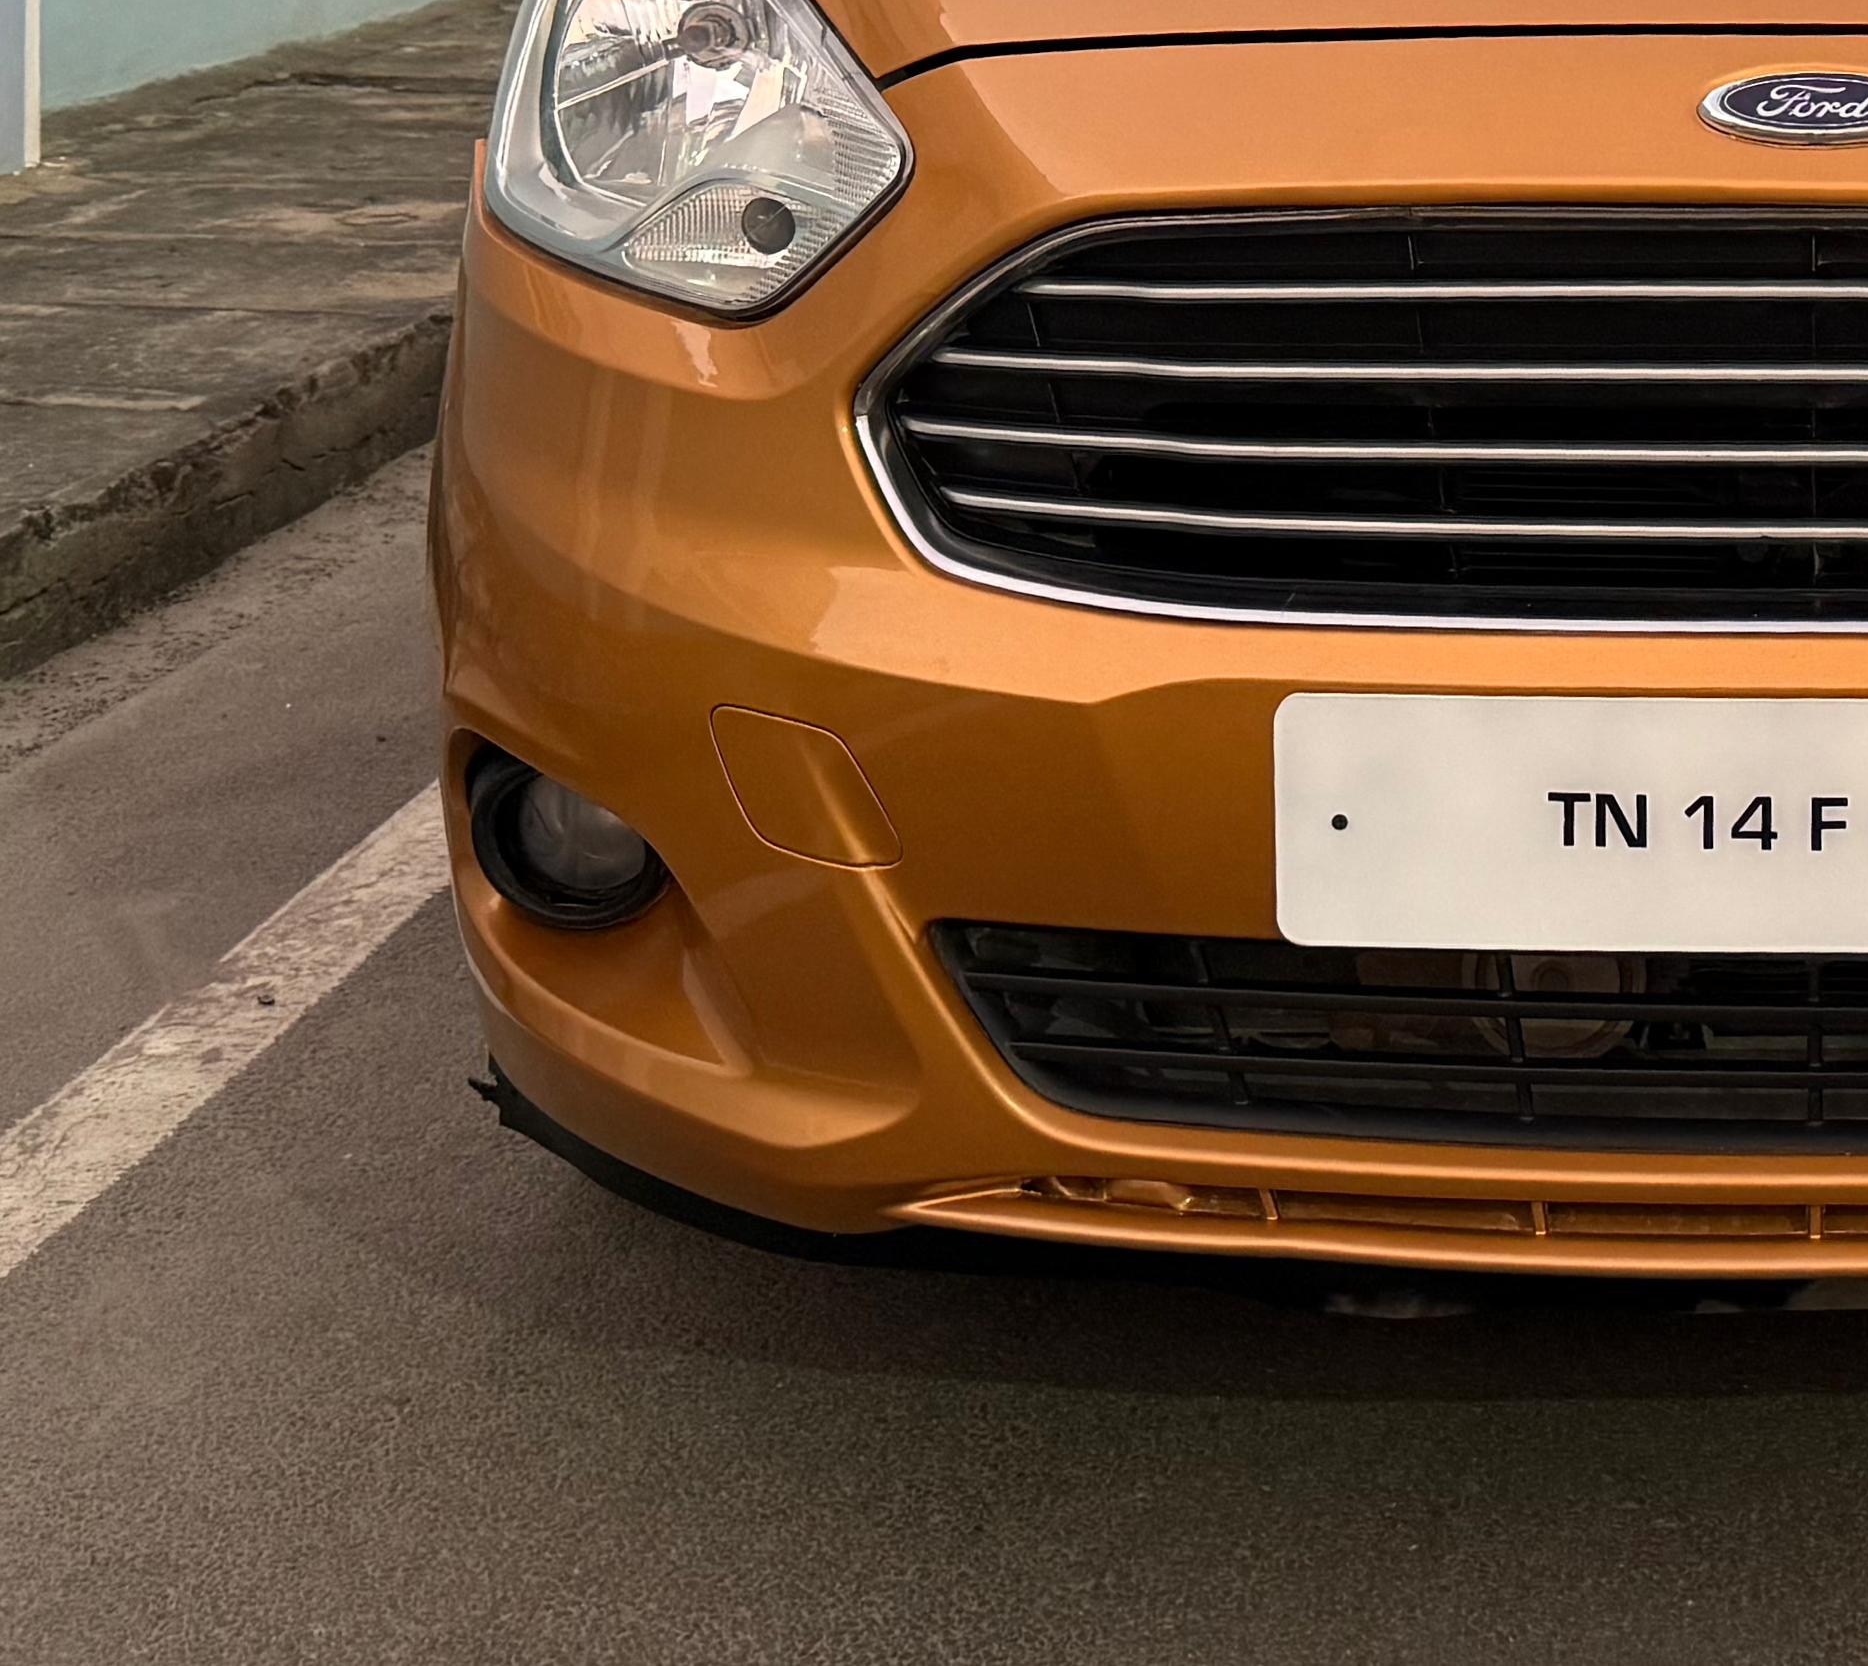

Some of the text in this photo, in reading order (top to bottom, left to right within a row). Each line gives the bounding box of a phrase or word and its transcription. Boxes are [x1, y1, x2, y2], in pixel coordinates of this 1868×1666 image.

[1547, 791, 1648, 849] TN
[1684, 795, 1778, 851] 14
[1810, 796, 1849, 852] F
